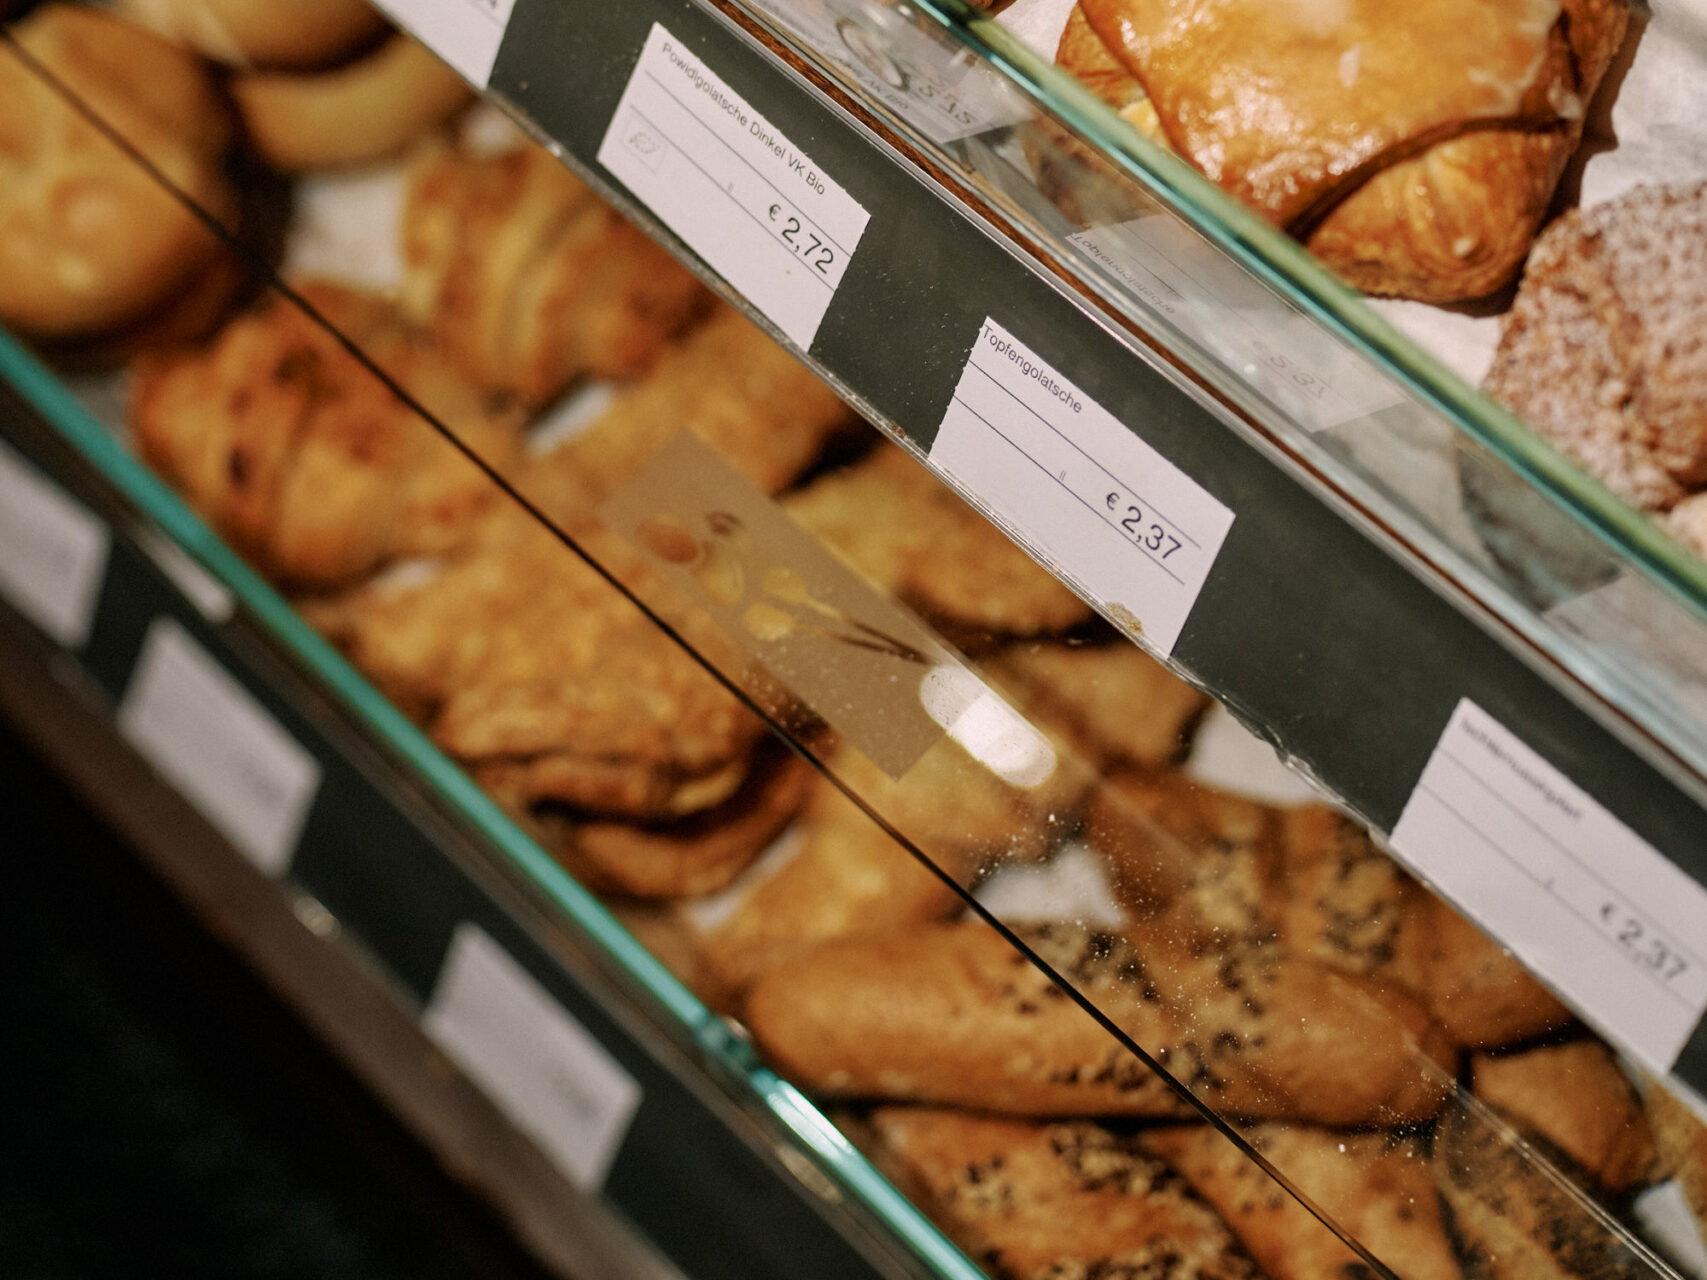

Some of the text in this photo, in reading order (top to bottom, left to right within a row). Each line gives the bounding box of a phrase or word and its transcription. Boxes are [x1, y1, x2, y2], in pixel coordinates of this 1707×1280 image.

[749, 121, 786, 160] Dinkel
[787, 153, 805, 178] VK
[805, 171, 825, 195] Bio
[769, 204, 834, 274] € 2,72
[982, 324, 1083, 414] Topfengolatsche
[1105, 492, 1182, 559] € 2,37
